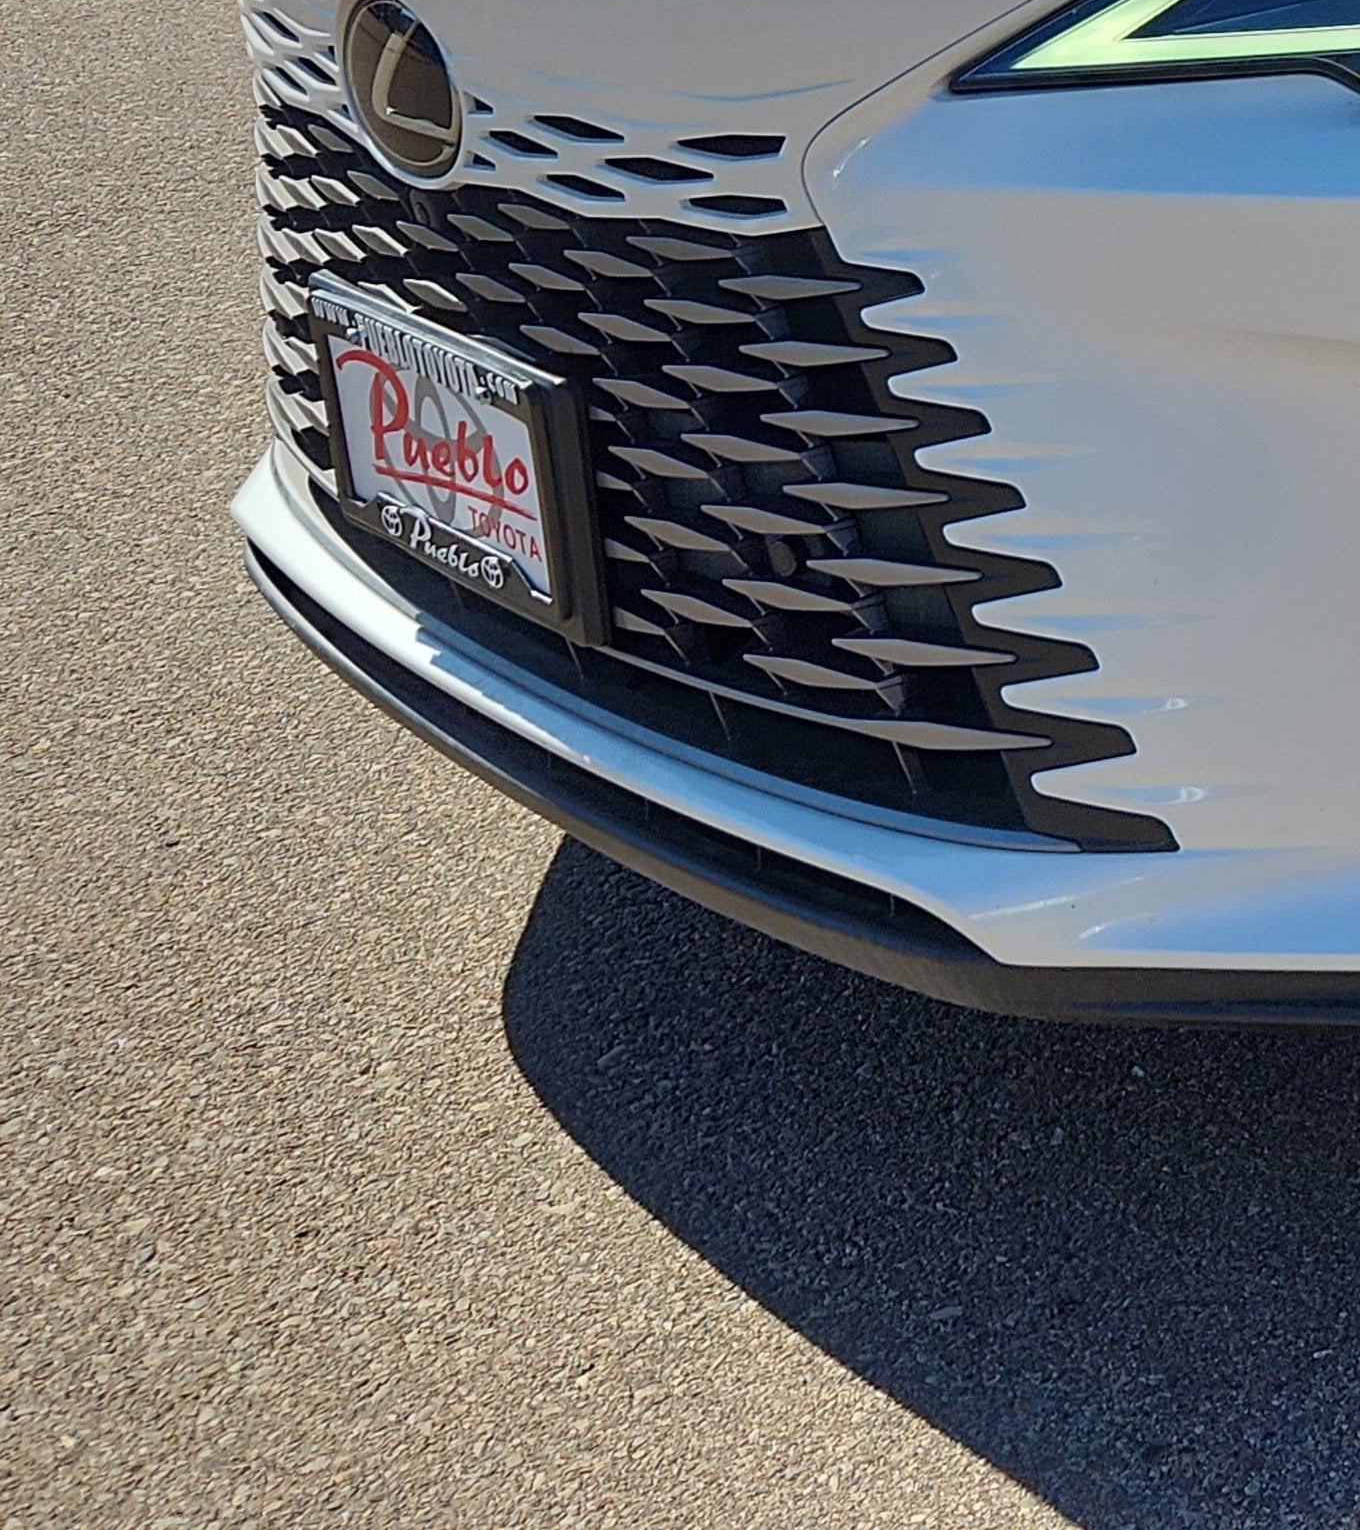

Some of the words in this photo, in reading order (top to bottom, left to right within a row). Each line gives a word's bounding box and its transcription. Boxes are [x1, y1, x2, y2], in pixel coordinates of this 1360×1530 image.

[335, 349, 530, 496] Pueblo
[397, 504, 480, 579] Pueblo
[467, 504, 543, 563] TOYOTA
